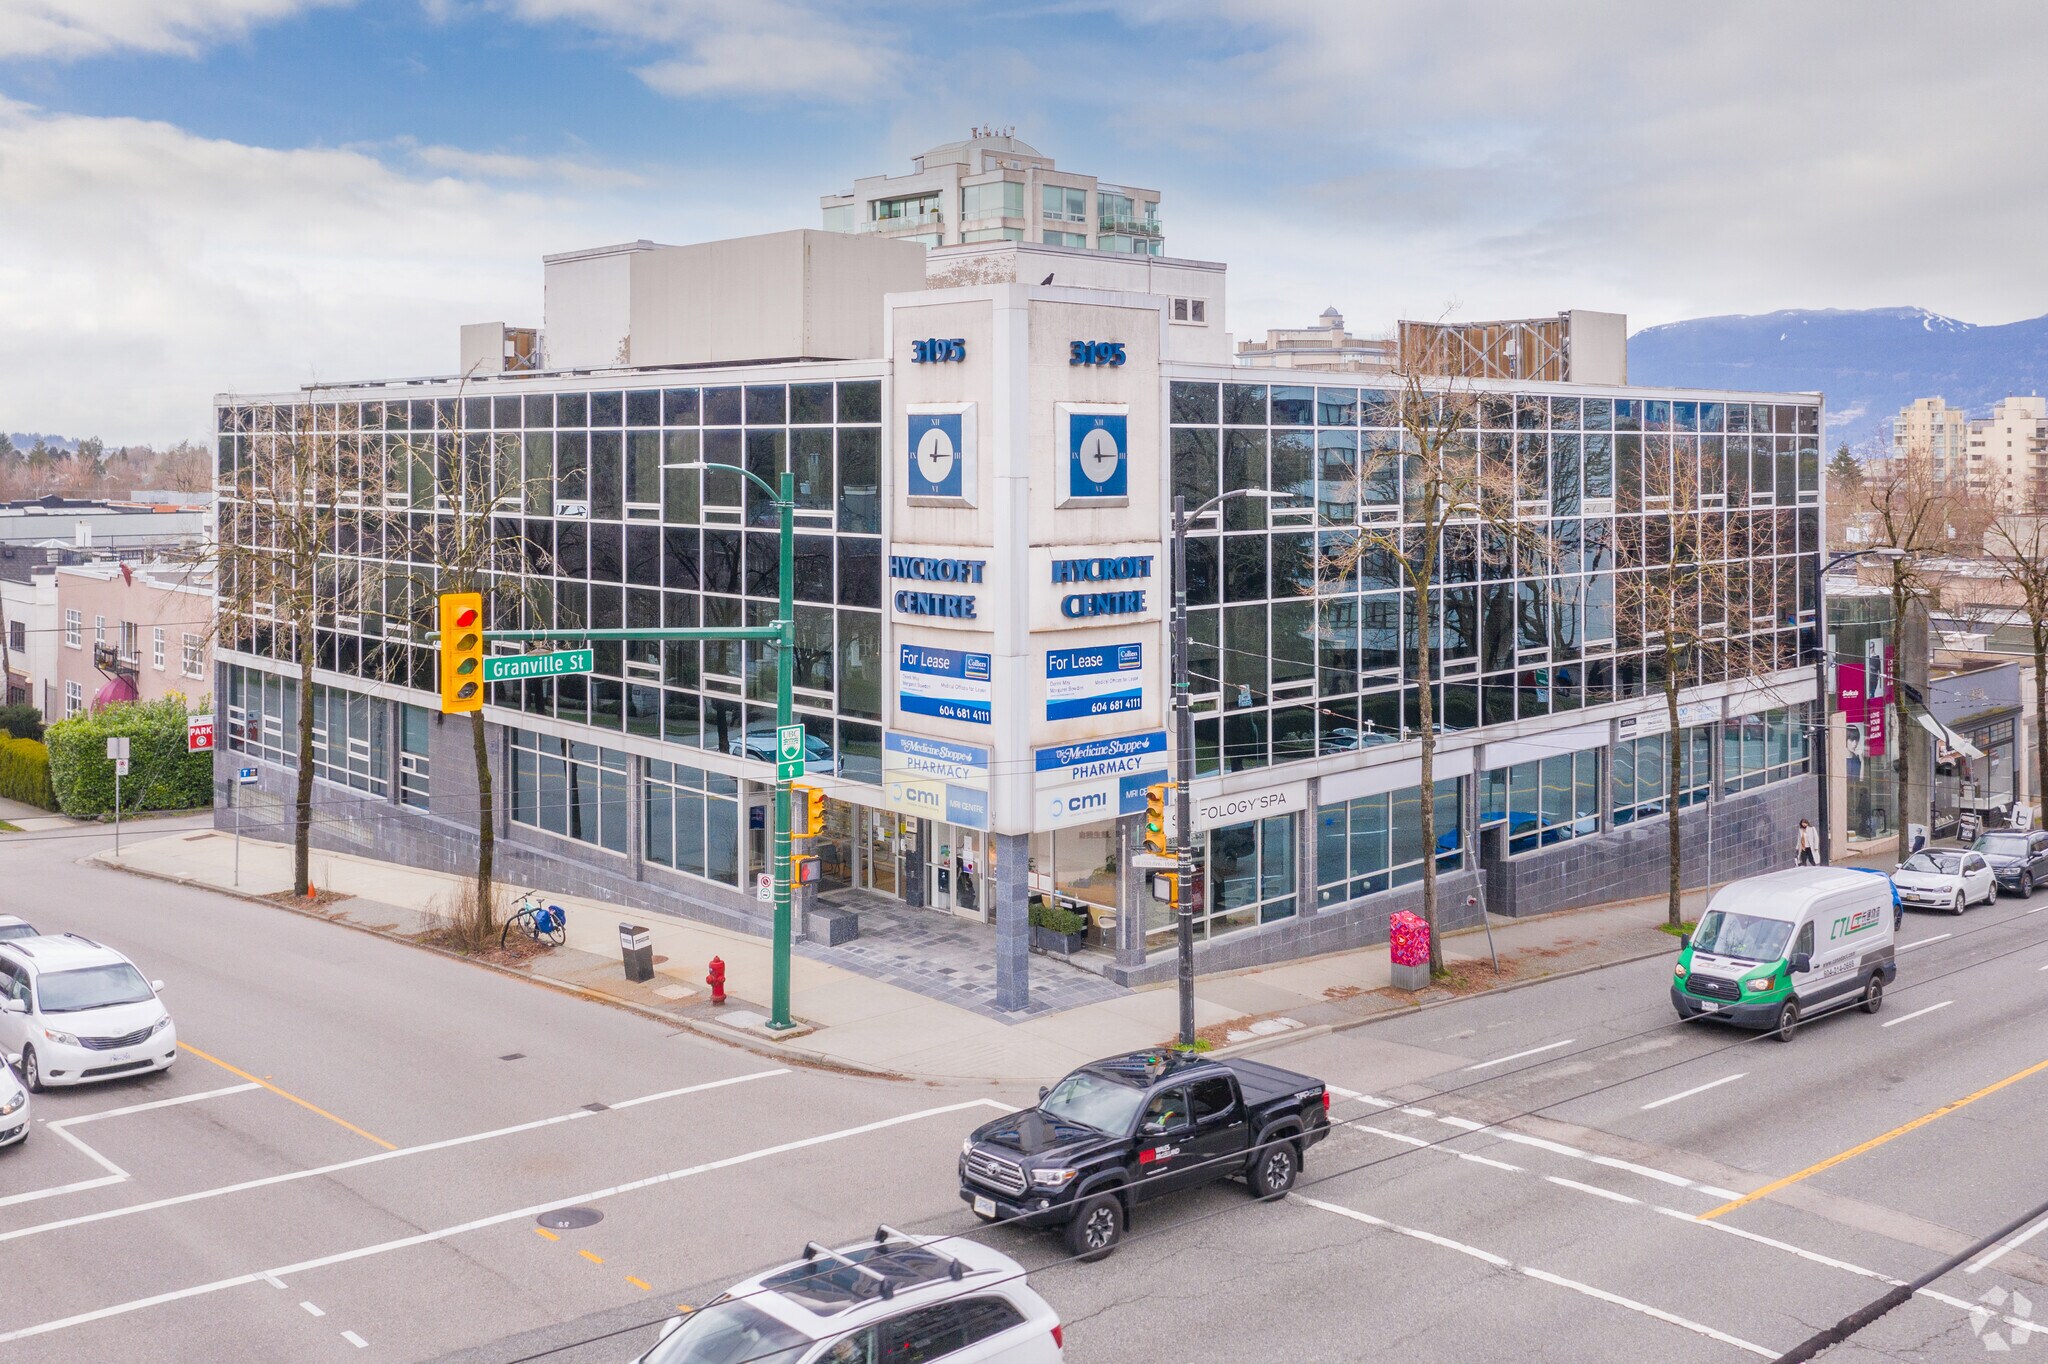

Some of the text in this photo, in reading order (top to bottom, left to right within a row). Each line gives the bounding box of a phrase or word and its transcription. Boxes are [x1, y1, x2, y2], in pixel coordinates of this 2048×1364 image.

[911, 338, 966, 364] 3195
[1069, 340, 1126, 366] 3195
[888, 555, 986, 584] HYCROFT
[1051, 555, 1154, 584] HYCROFT
[894, 590, 977, 619] CENTRE
[1061, 590, 1148, 619] CENTRE
[902, 649, 950, 669] For Lease
[968, 658, 987, 668] Colliers
[1049, 653, 1103, 671] For Lease
[1120, 650, 1138, 658] Colliers
[493, 654, 584, 677] Granville St
[939, 705, 989, 722] 604 681 4111
[1091, 697, 1140, 713] 604 681 4111
[190, 726, 212, 736] PARK
[783, 729, 798, 738] UBC
[904, 740, 940, 757] Medicine
[939, 746, 966, 762] Shoppe
[1060, 744, 1109, 764] Medicine
[1108, 740, 1142, 756] Shoppe
[907, 757, 969, 779] PHARMACY
[1072, 757, 1142, 779] PHARMACY
[1125, 789, 1138, 799] MRI
[1260, 793, 1287, 809] SPA
[949, 799, 961, 809] MRI
[962, 801, 984, 814] CENTRE
